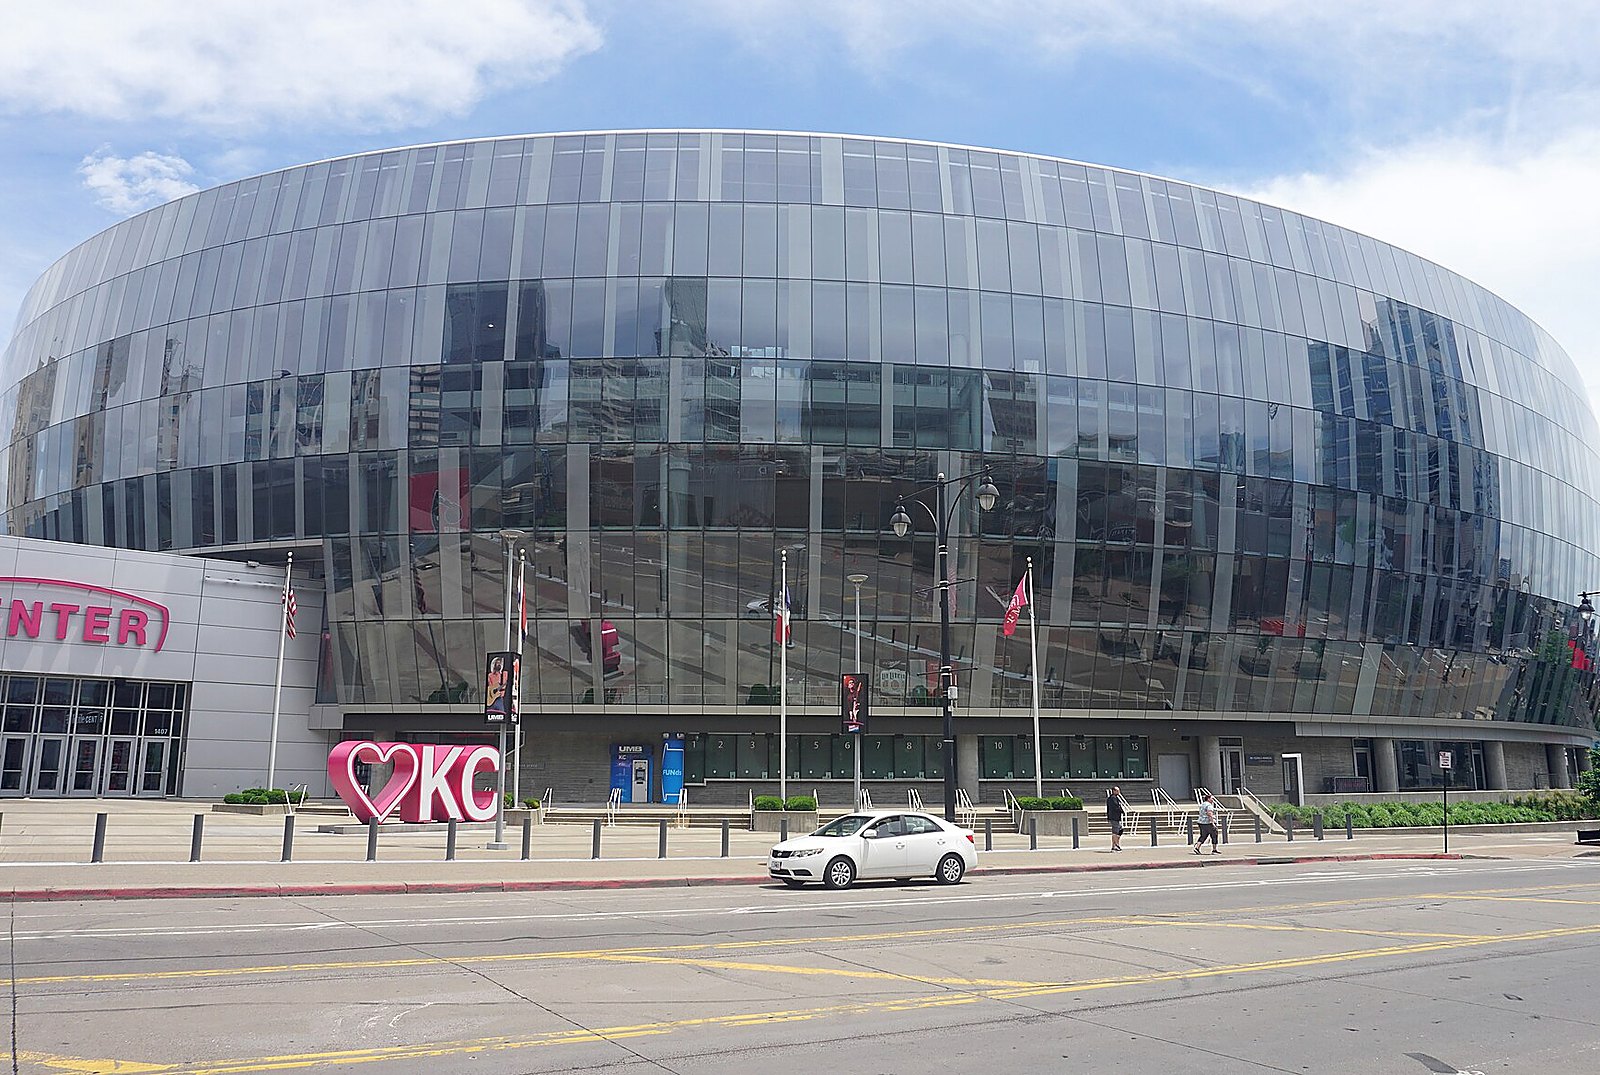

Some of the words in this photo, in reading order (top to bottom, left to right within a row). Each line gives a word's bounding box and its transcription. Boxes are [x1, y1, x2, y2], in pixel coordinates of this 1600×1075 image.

[0, 598, 150, 646] NTER
[692, 740, 696, 748] 1
[718, 741, 724, 749] 2
[750, 741, 756, 749] 3
[814, 741, 819, 749] 5
[844, 741, 851, 749] 6
[876, 741, 881, 749] 7
[906, 742, 912, 750] 8
[936, 741, 942, 749] 9
[994, 741, 1003, 750] 10
[1024, 742, 1031, 750] 11
[1052, 742, 1059, 750] 12
[1079, 742, 1087, 750] 13
[1105, 743, 1113, 751] 14
[1131, 743, 1139, 751] 15
[618, 745, 643, 753] UMB
[662, 769, 682, 777] FUNds
[418, 745, 500, 822] KC
